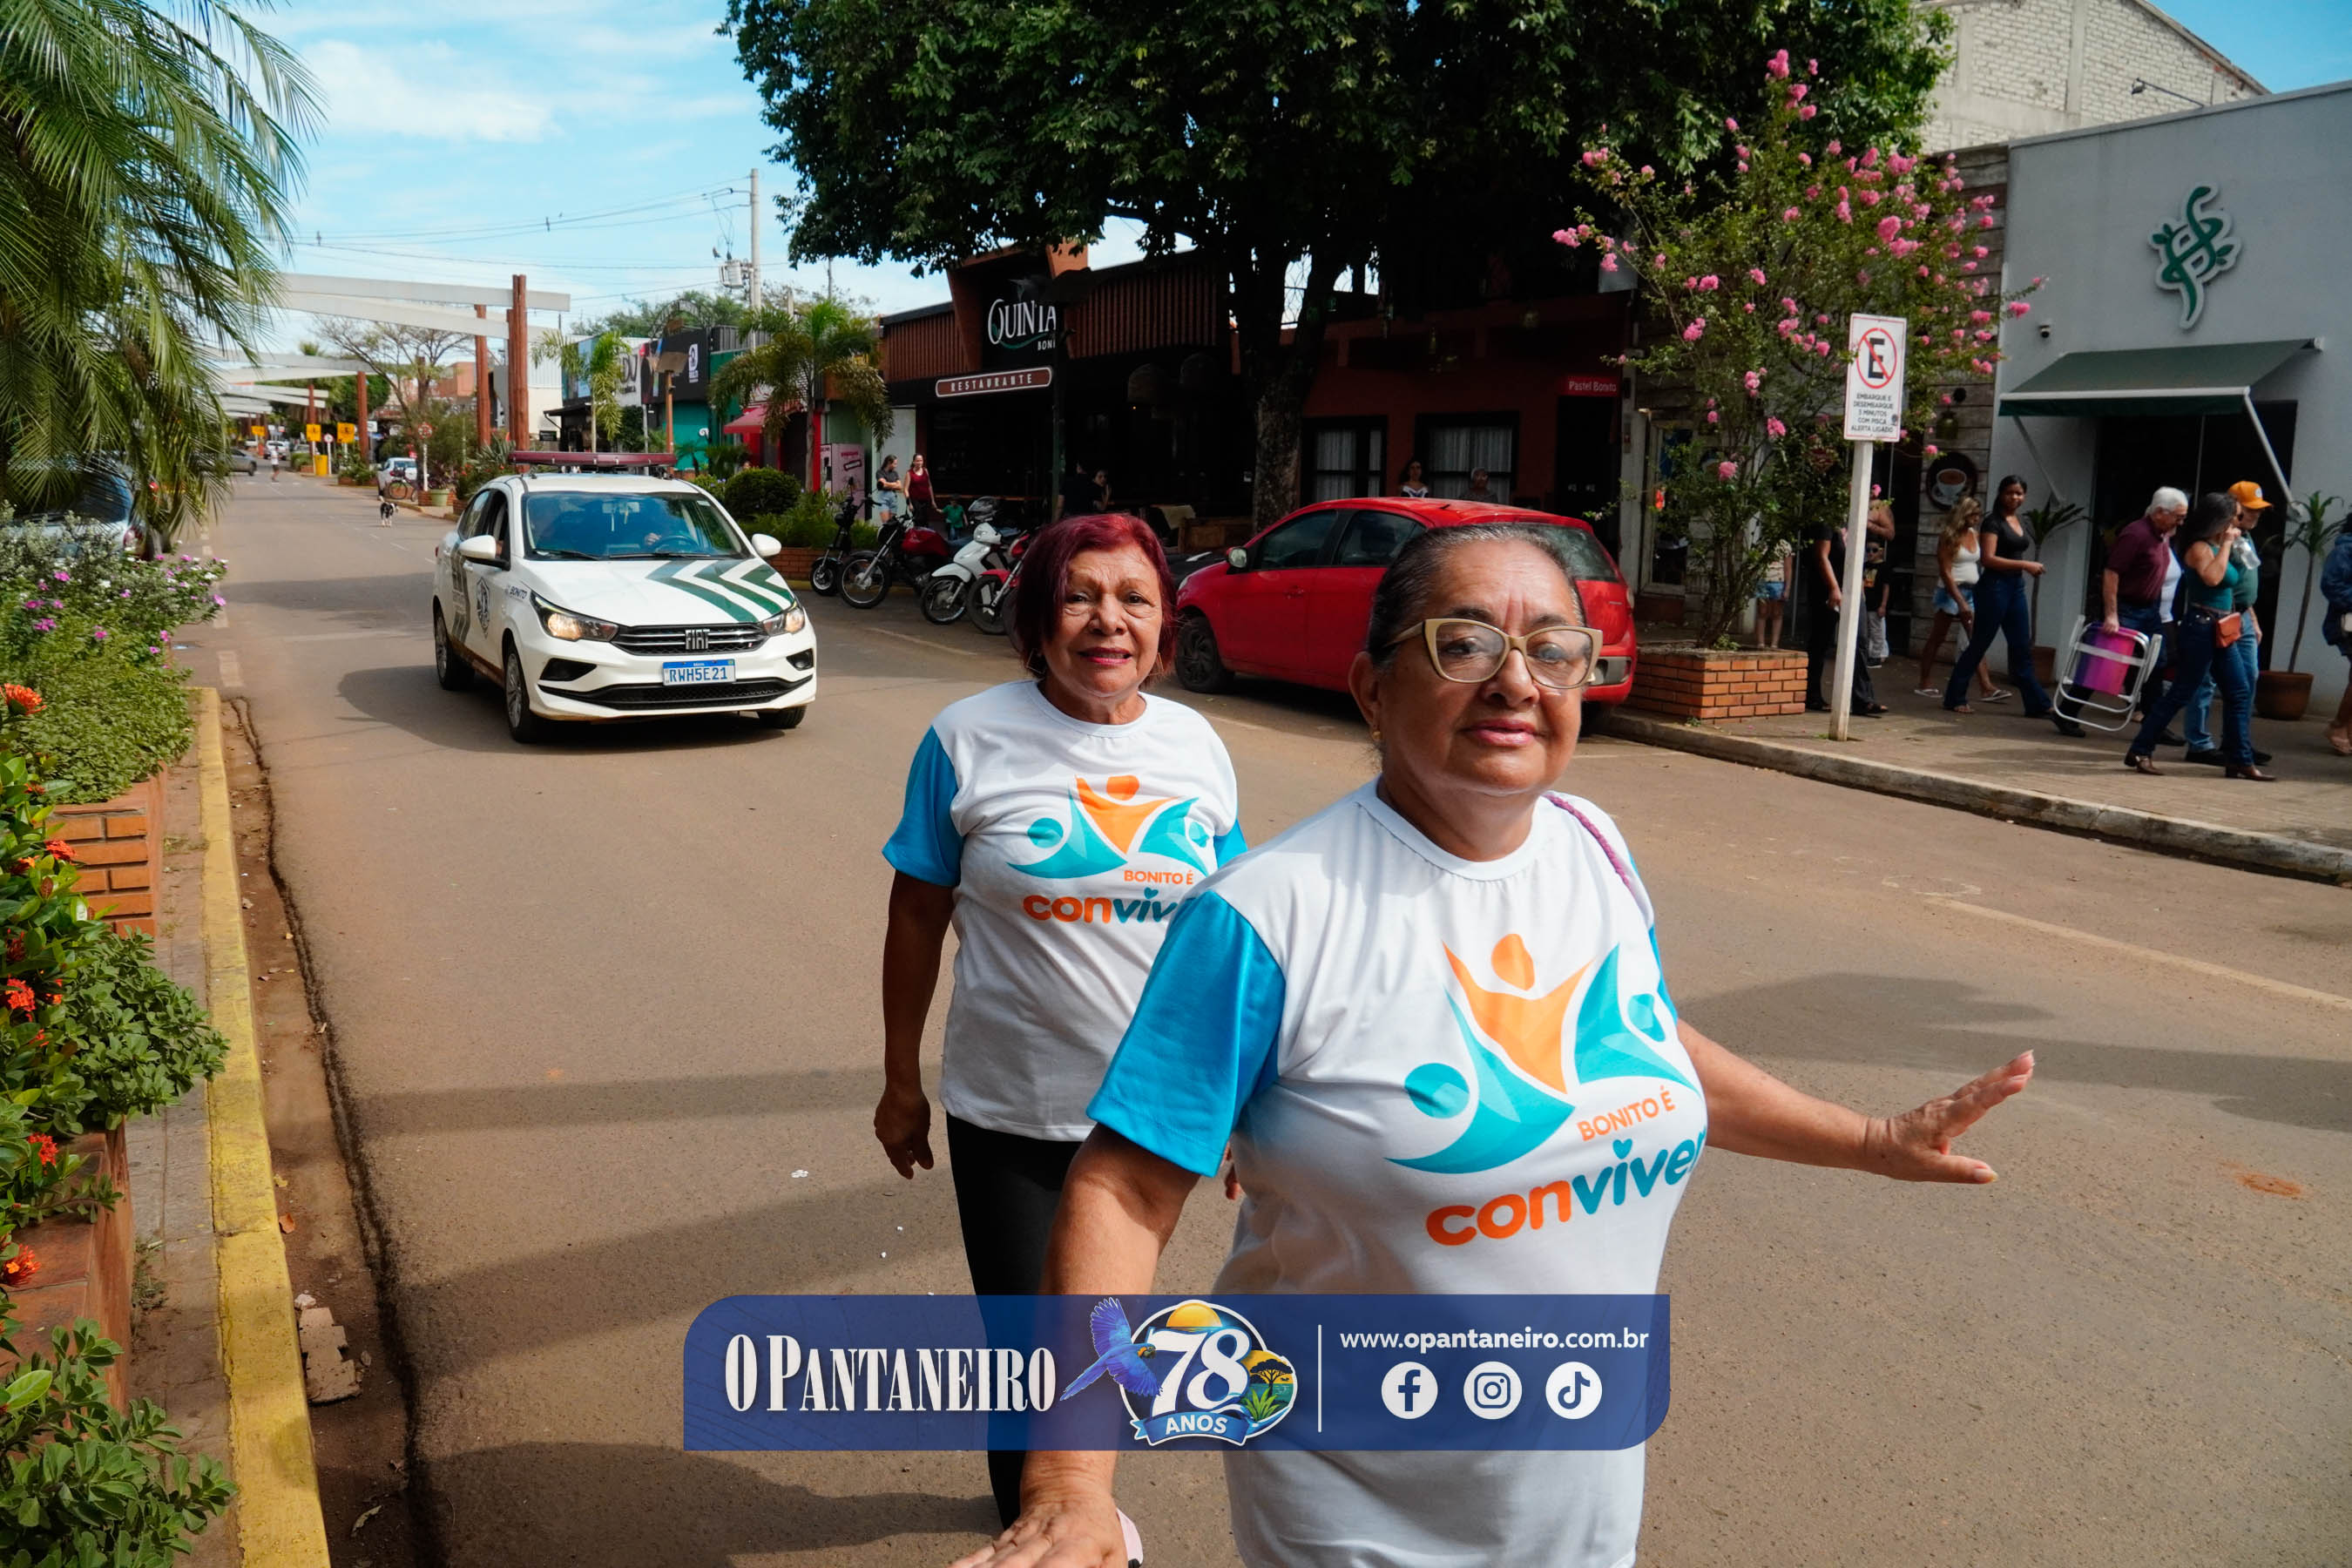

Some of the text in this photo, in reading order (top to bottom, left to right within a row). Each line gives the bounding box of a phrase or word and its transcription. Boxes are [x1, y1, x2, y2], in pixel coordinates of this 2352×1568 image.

[988, 298, 1057, 345] QUINTA
[950, 373, 1032, 392] RESTAURANTE
[1568, 381, 1617, 392] Pastel Bonito
[1853, 401, 1894, 409] DESEMBARQUE
[686, 629, 710, 649] FIAT
[669, 667, 727, 683] RWH5E21
[1124, 869, 1194, 885] BONITO É
[1023, 887, 1179, 923] conviv
[1577, 1085, 1676, 1141] BONITO É
